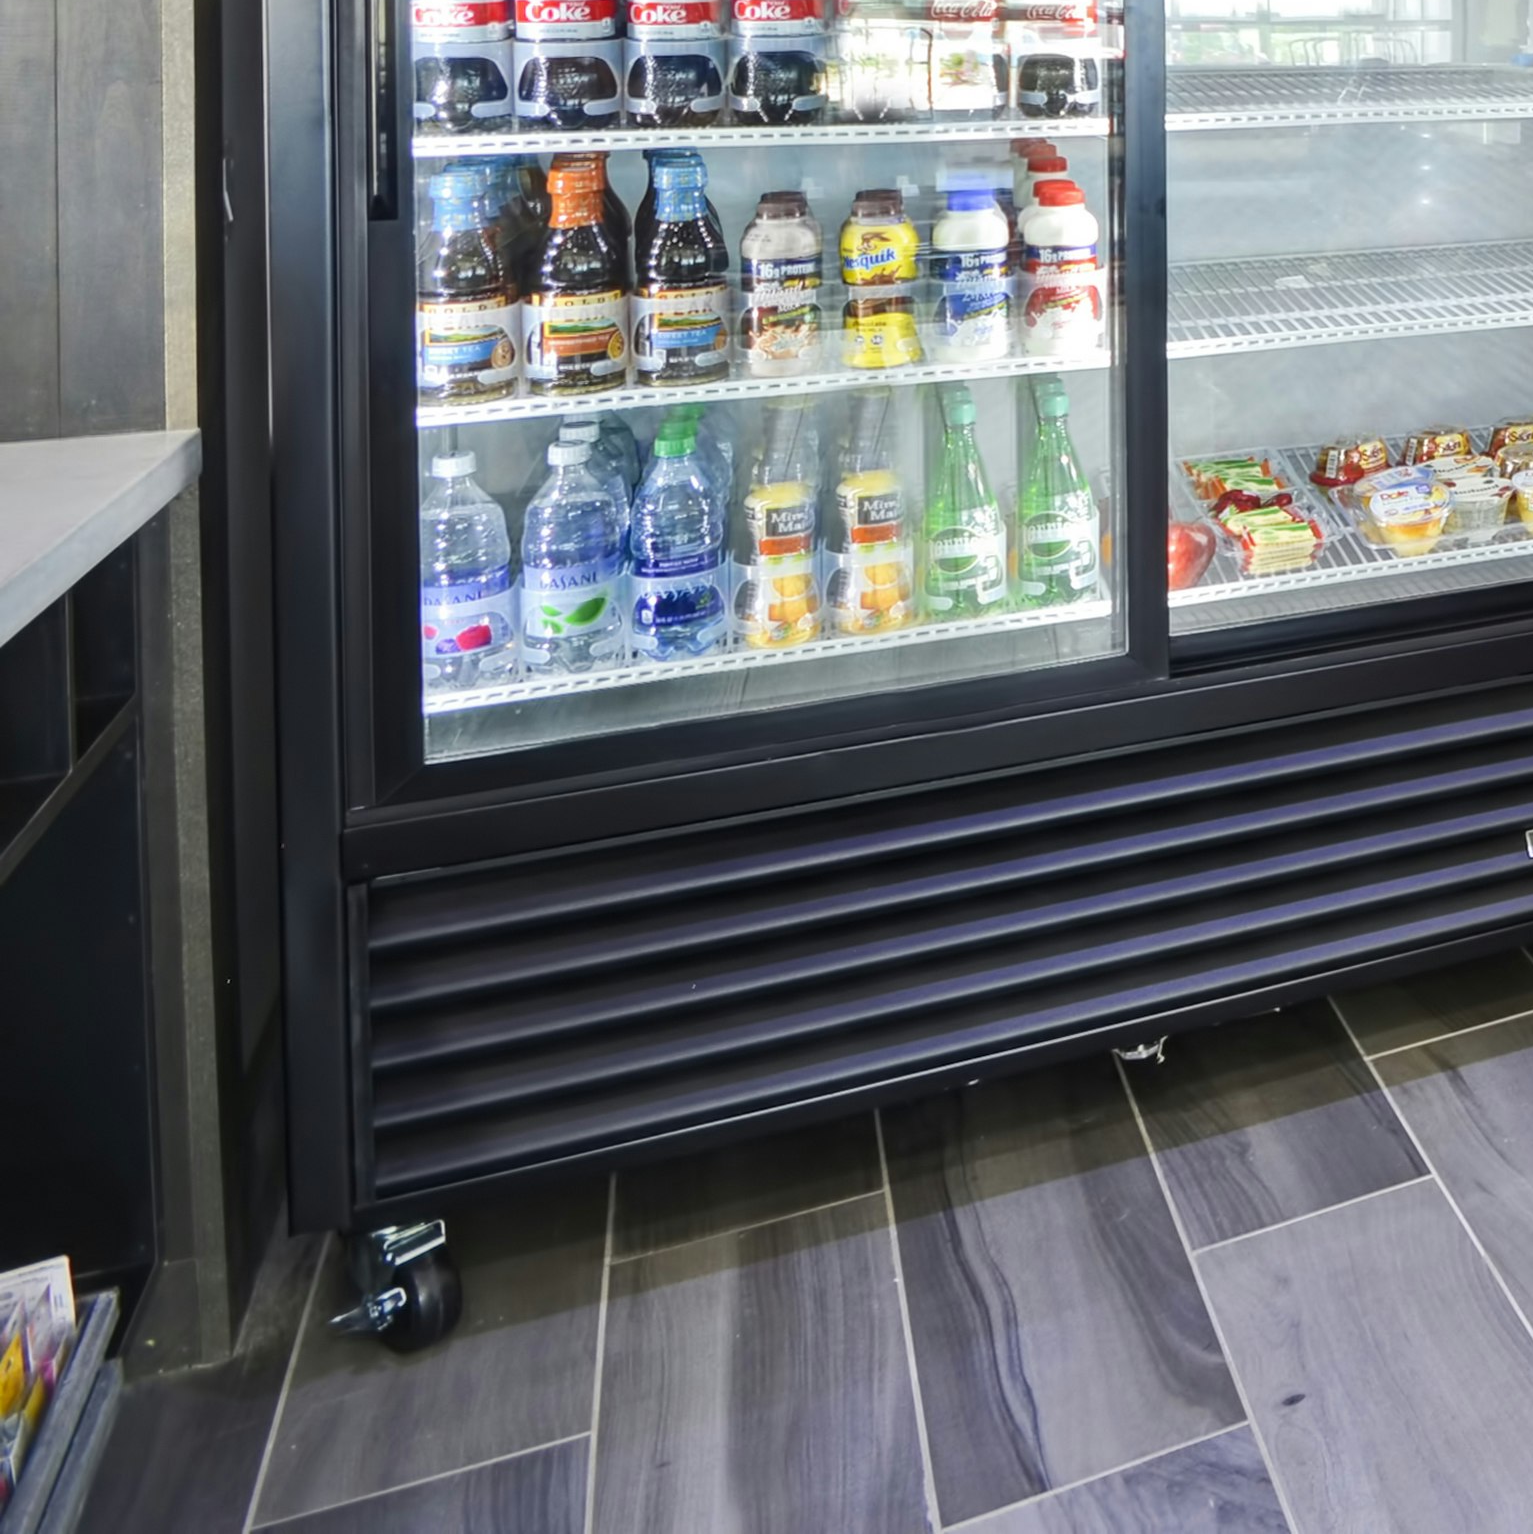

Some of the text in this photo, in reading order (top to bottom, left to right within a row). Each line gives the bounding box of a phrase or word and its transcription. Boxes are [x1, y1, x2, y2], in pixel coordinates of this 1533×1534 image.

[525, 1, 590, 23] Coke
[629, 3, 688, 25] Coke
[733, 0, 791, 22] Coke
[843, 249, 896, 271] Nesquik
